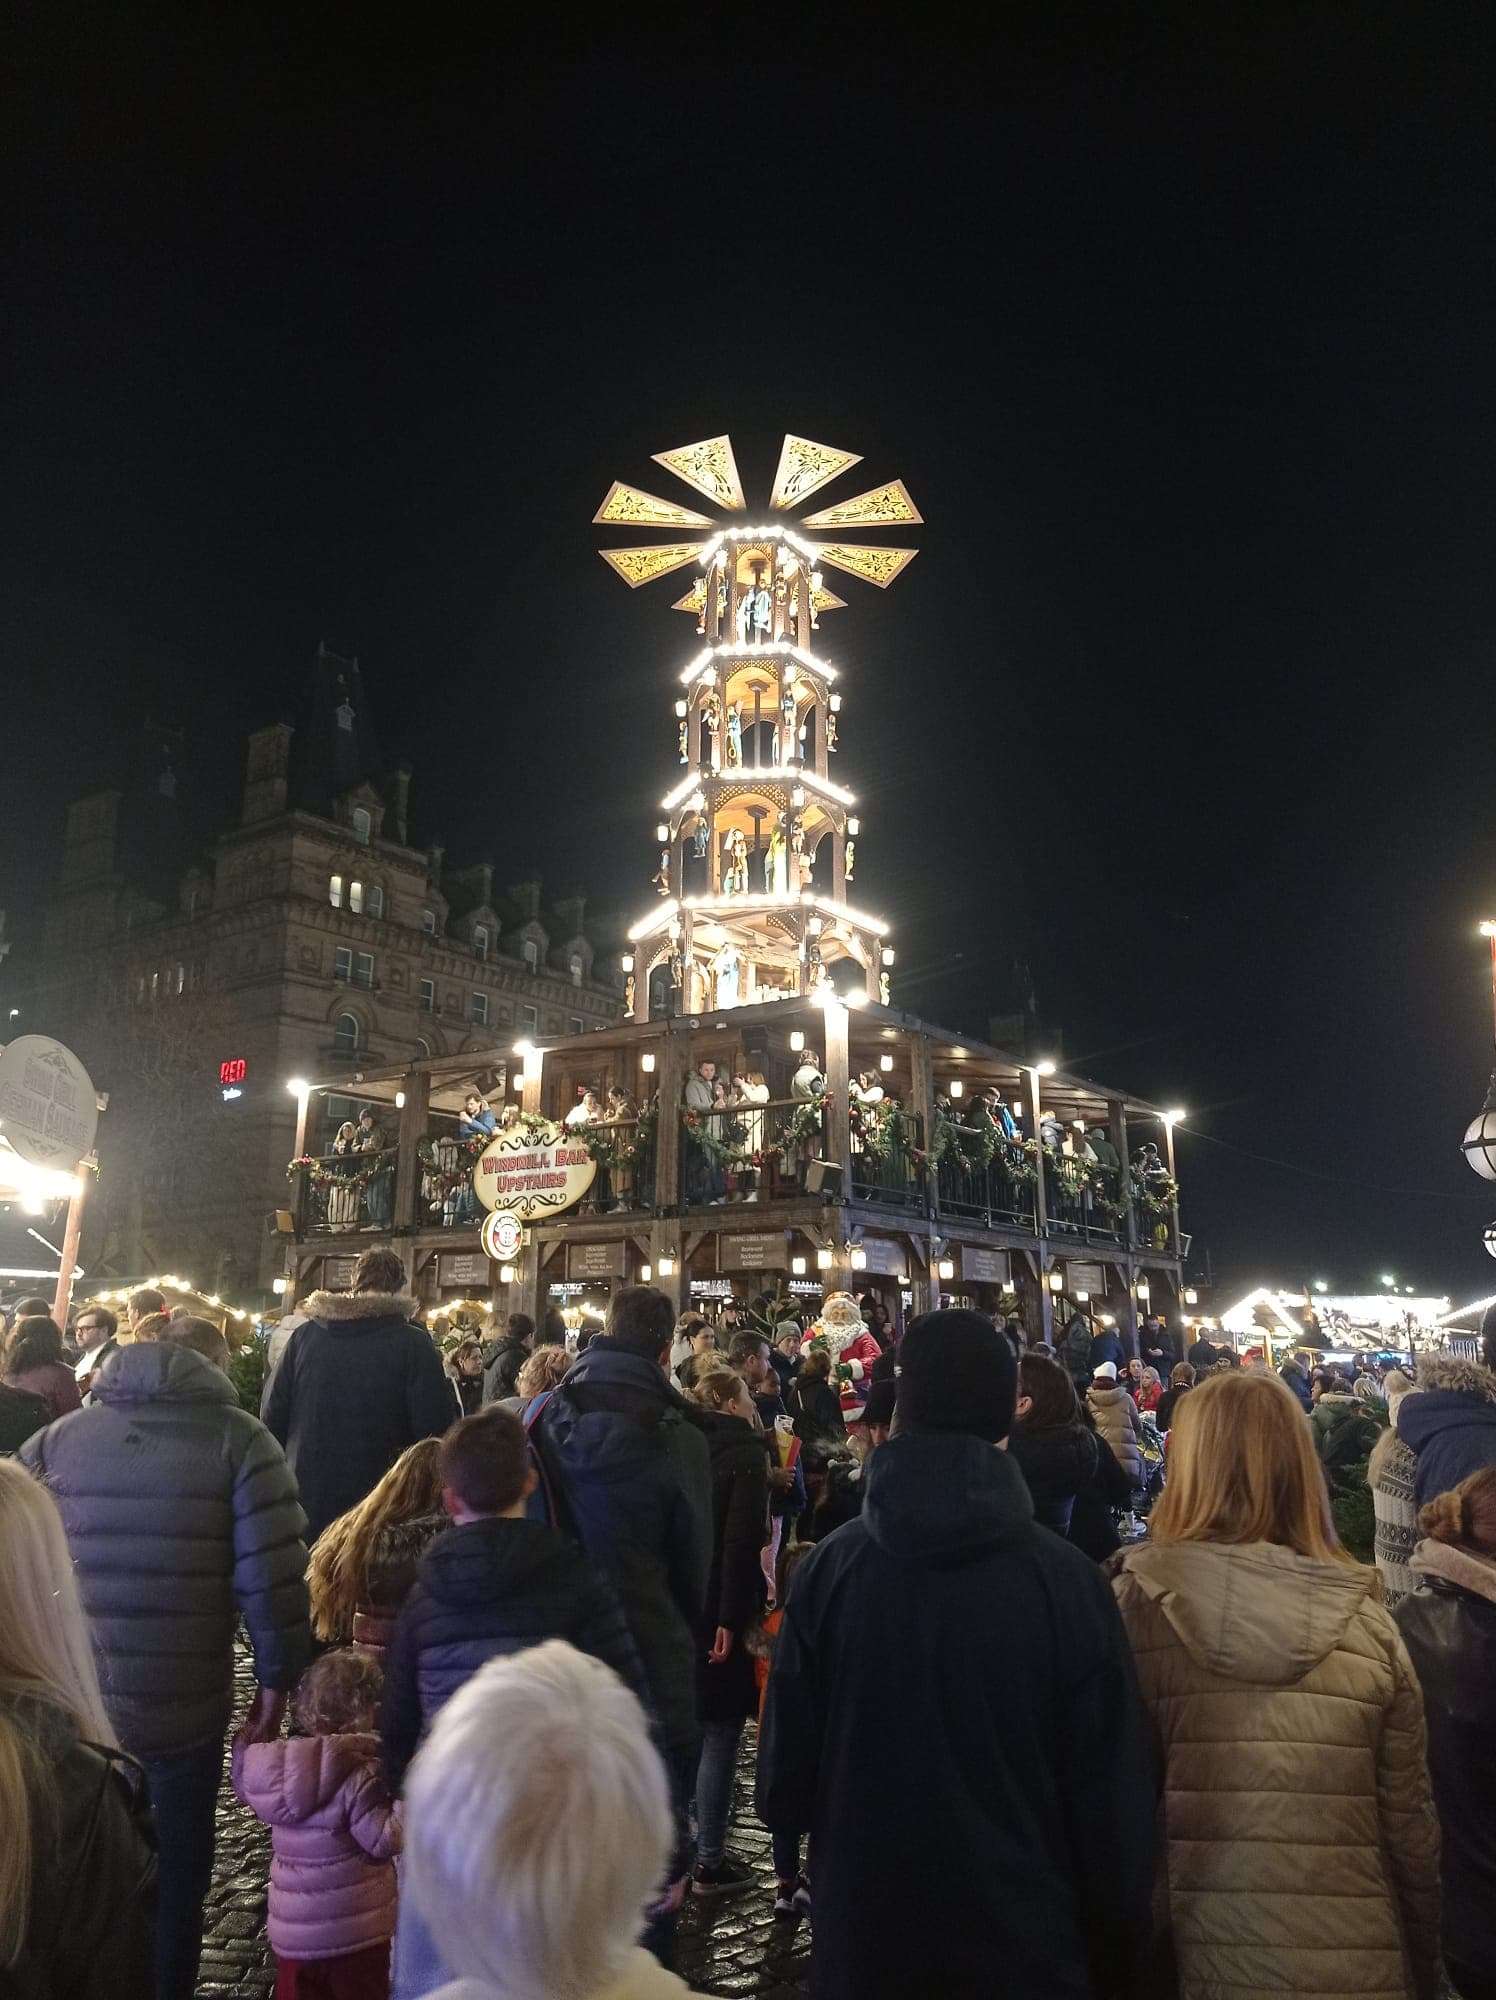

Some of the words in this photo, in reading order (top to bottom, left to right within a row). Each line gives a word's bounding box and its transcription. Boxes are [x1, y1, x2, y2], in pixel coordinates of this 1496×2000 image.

[220, 1059, 246, 1084] RED
[482, 1151, 551, 1175] WINDMILL
[554, 1148, 589, 1167] BAR
[496, 1171, 567, 1193] UPSTAIRS
